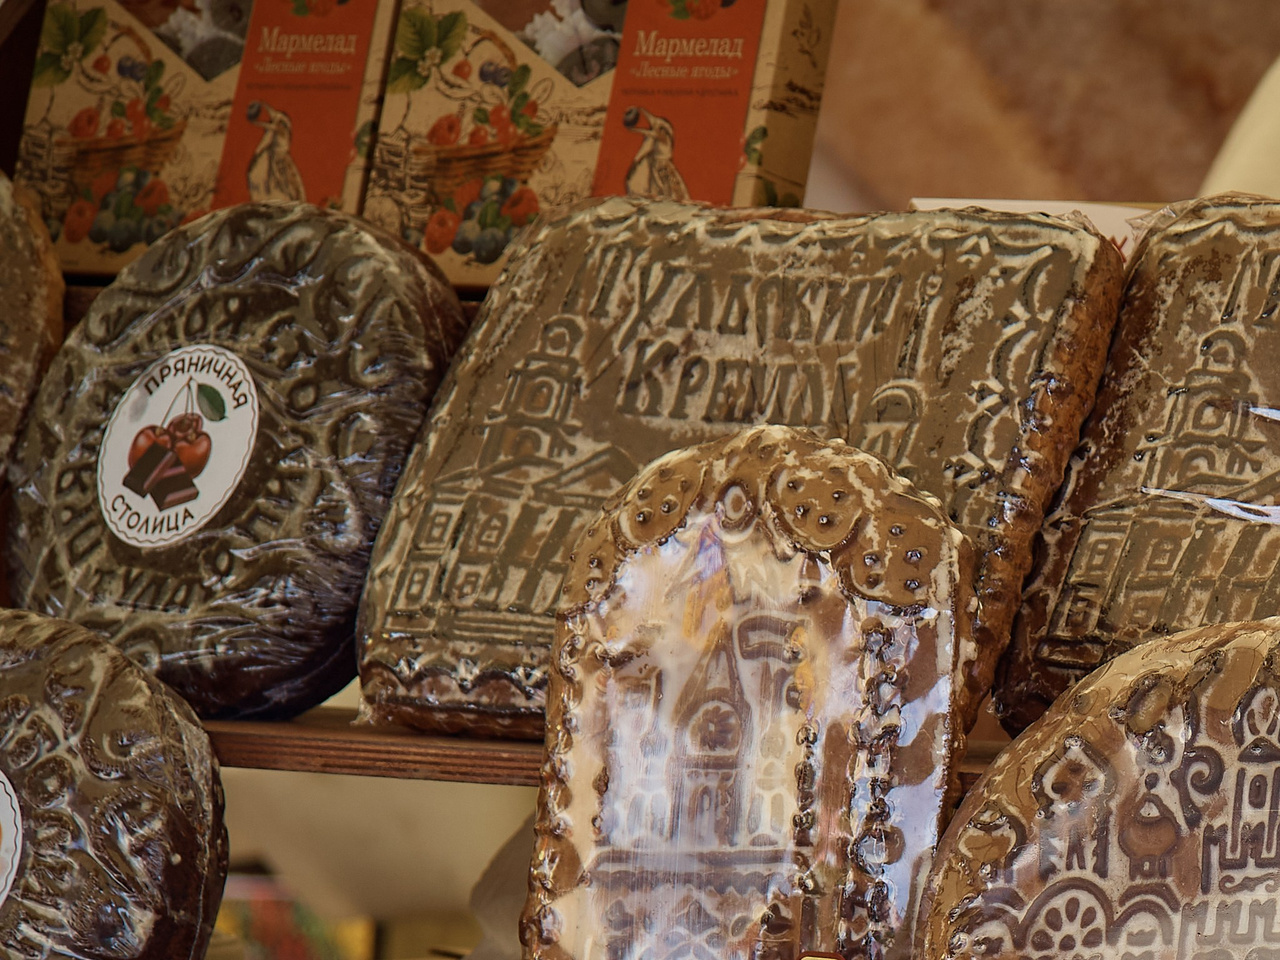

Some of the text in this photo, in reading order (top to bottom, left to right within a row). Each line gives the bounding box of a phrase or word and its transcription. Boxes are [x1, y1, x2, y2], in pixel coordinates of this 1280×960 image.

[257, 26, 358, 59] Мармелад
[632, 30, 745, 63] Мармелад
[143, 355, 249, 410] ПРЯНИЧНАЯ
[111, 493, 195, 535] СТОЛИЦА
